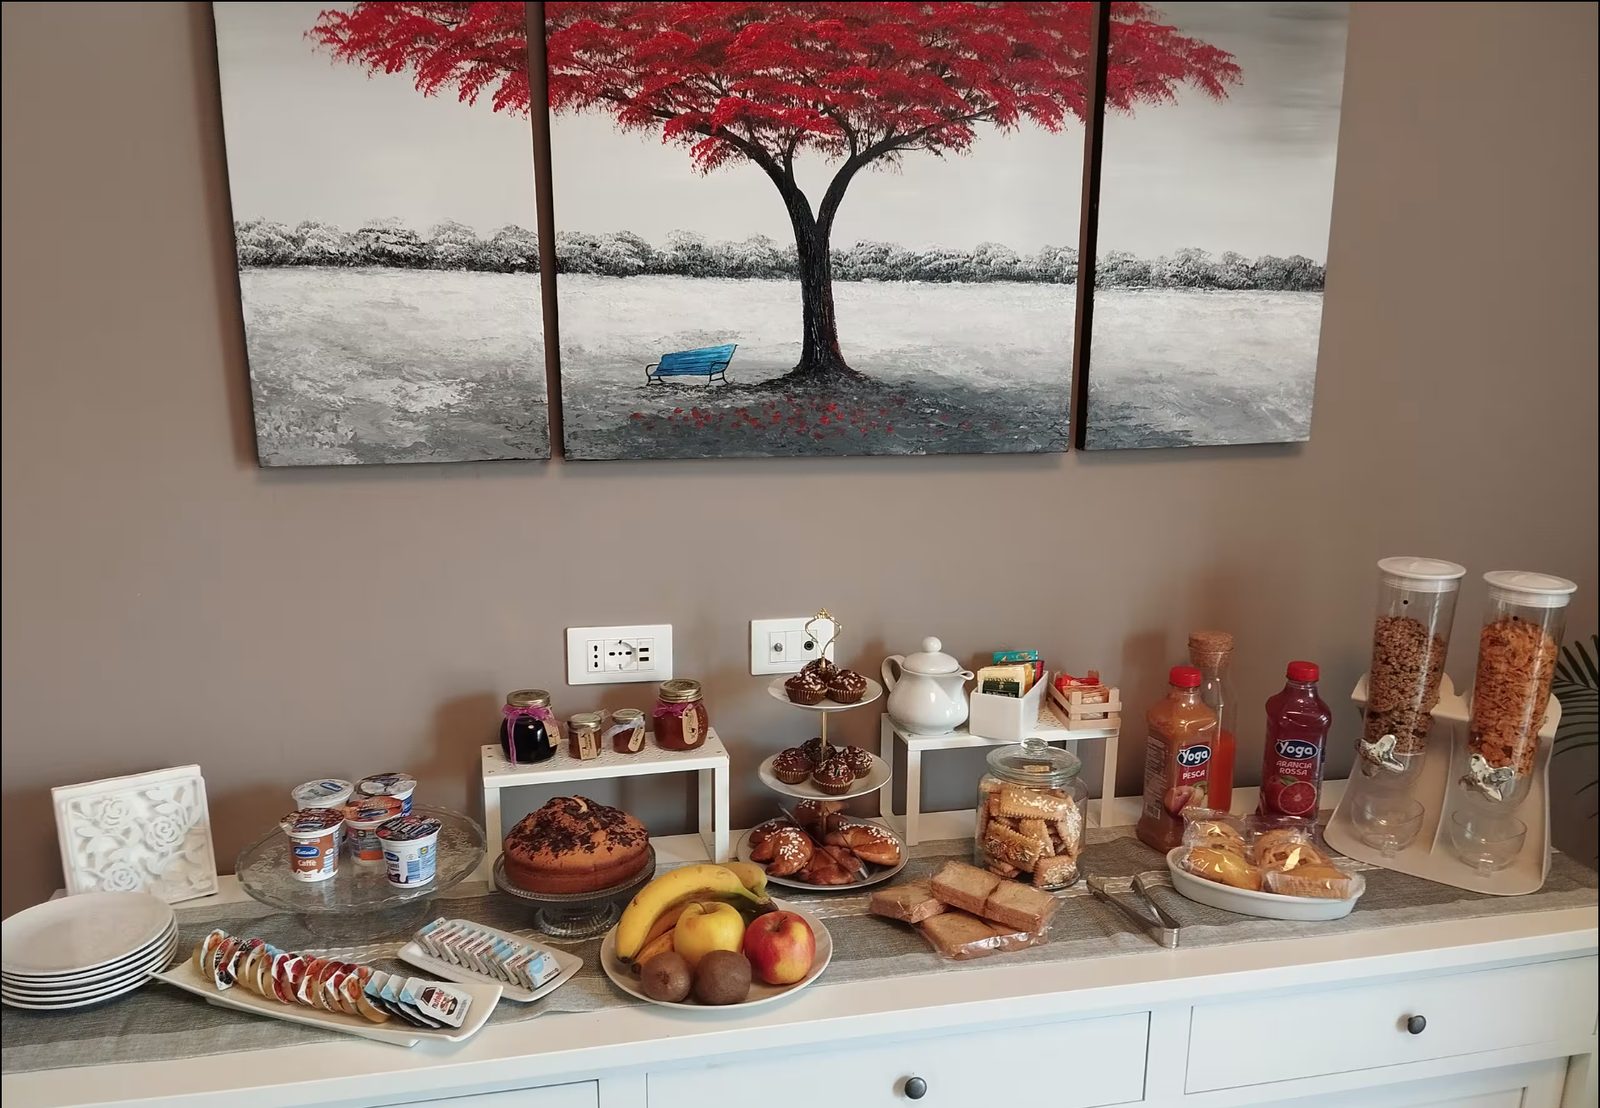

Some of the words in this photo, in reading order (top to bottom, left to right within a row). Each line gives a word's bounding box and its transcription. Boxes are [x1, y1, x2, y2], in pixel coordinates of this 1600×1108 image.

[1278, 740, 1313, 758] Yoga
[1179, 749, 1208, 764] Yoga
[1276, 760, 1312, 769] ARANCIA
[1182, 770, 1205, 780] PESCA
[1279, 768, 1308, 776] ROSSA
